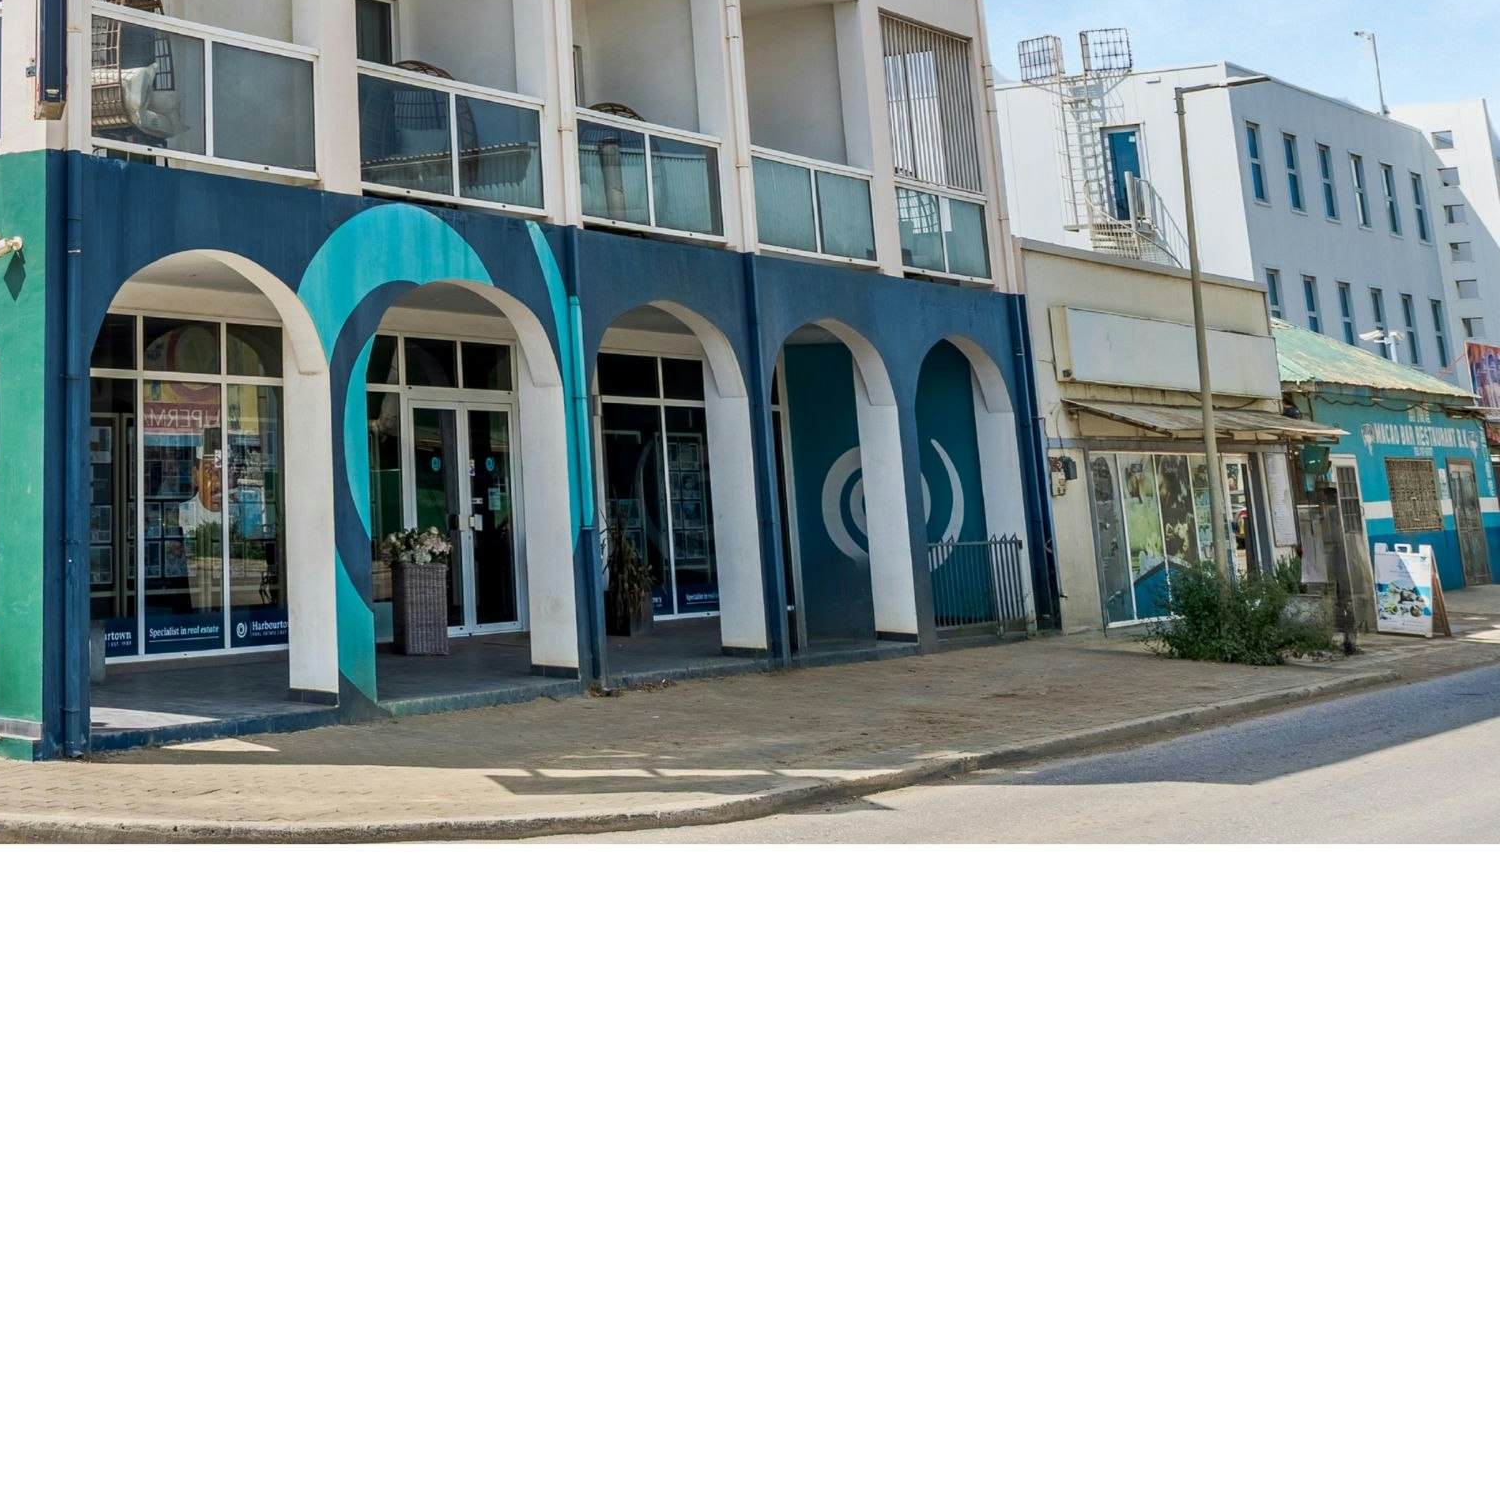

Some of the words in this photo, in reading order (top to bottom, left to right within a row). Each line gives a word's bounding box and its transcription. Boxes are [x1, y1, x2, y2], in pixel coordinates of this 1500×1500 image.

[1373, 422, 1400, 445] MACAO
[149, 626, 180, 639] Specialist
[180, 625, 187, 635] in
[187, 625, 200, 634] real
[200, 625, 219, 634] estate
